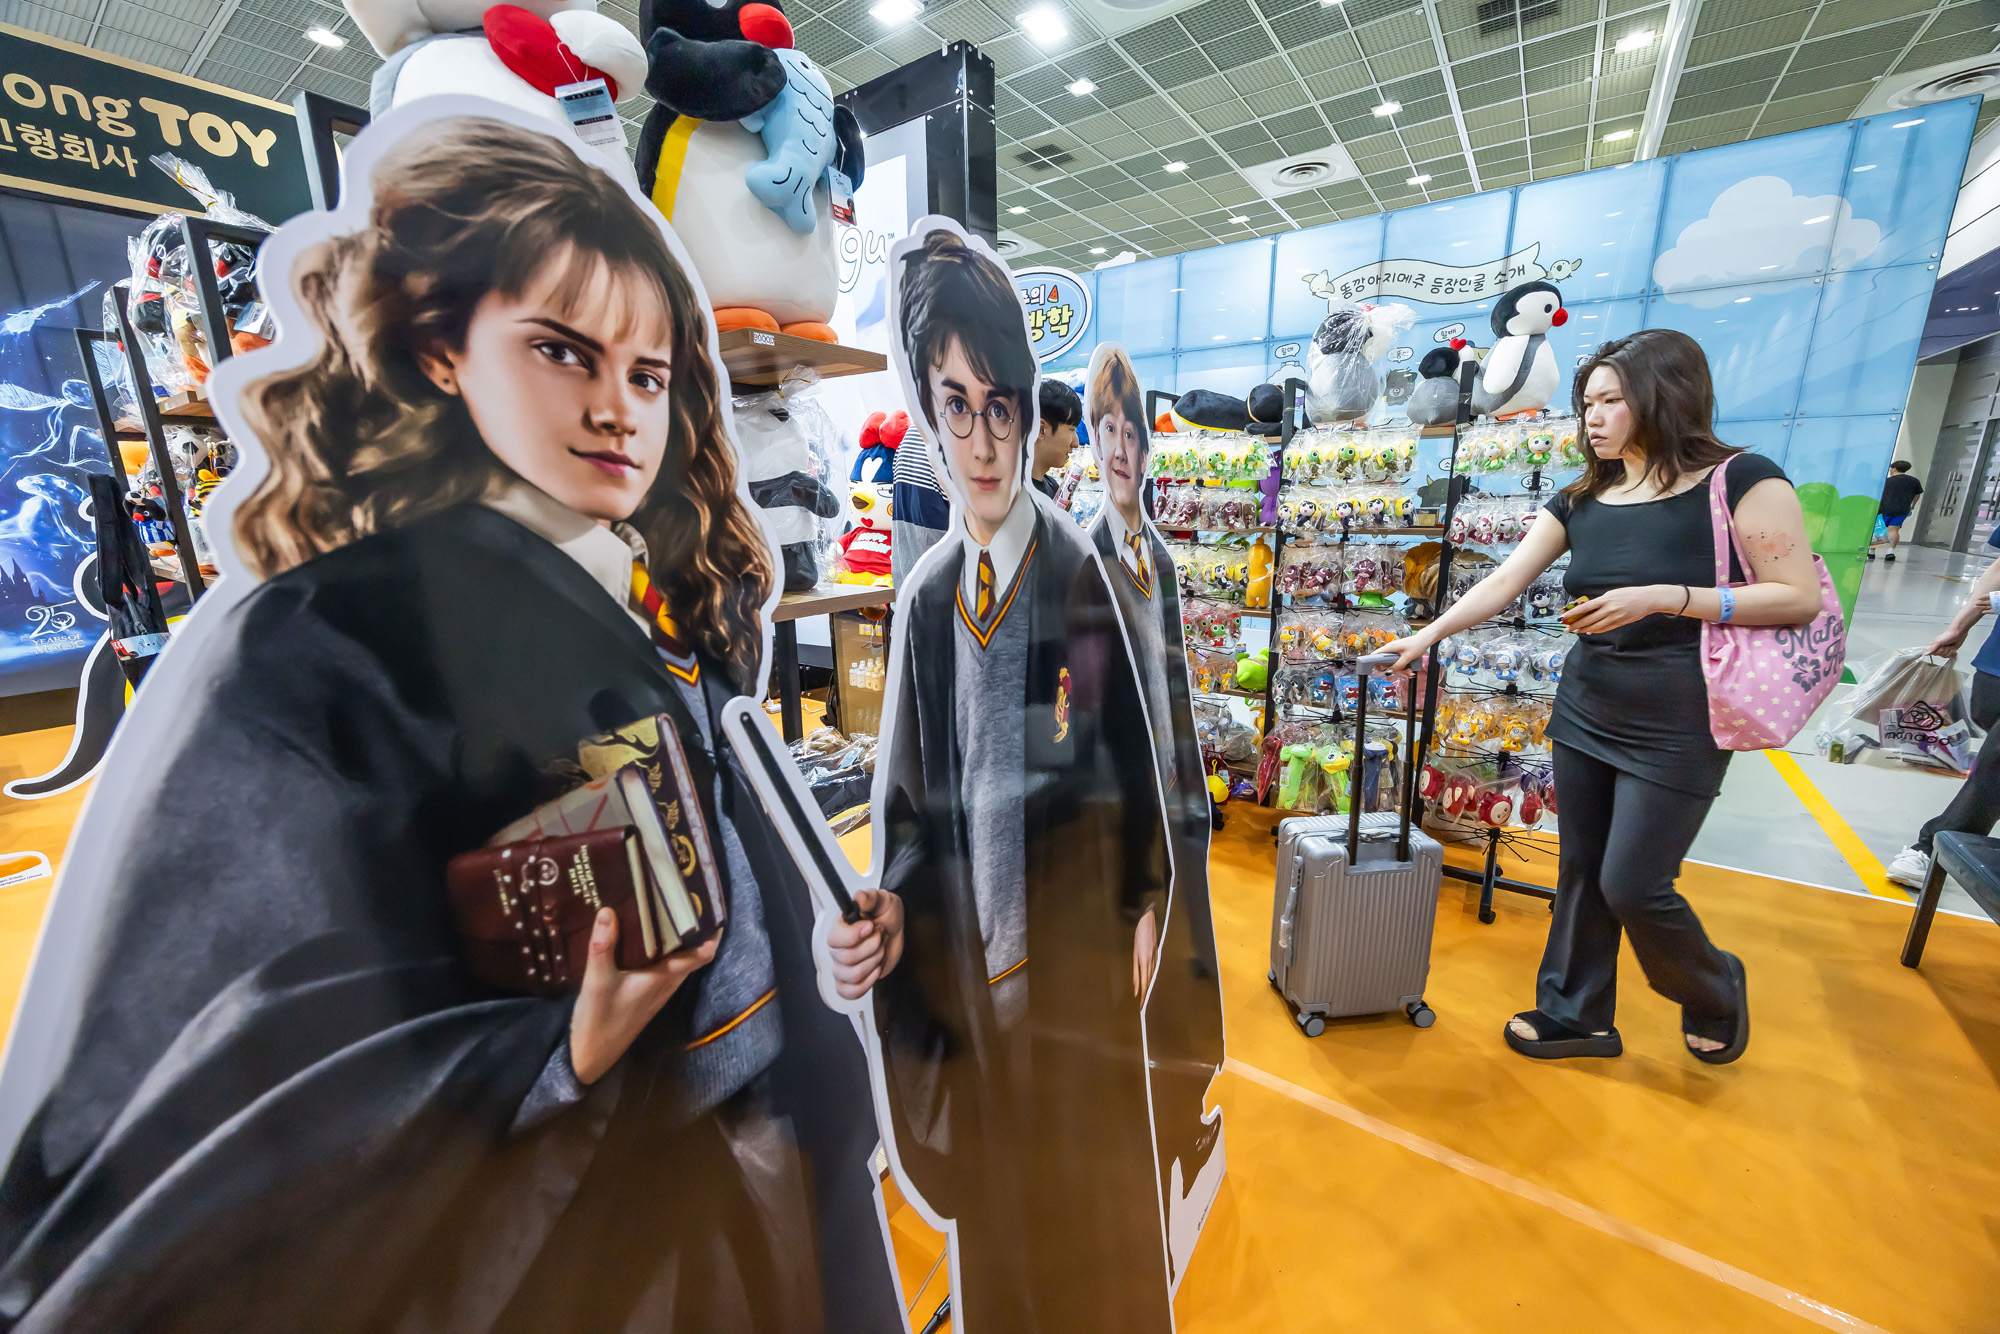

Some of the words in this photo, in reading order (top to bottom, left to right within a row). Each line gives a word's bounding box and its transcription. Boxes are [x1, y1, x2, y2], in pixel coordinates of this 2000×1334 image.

[2, 73, 136, 138] ong
[139, 96, 277, 168] TOY
[1340, 273, 1426, 299] 똥깡아지메주
[1430, 273, 1486, 295] 등장인물
[1493, 264, 1526, 286] 소개
[31, 635, 67, 646] YEARS
[68, 633, 82, 642] OF
[34, 639, 86, 655] MAGIC
